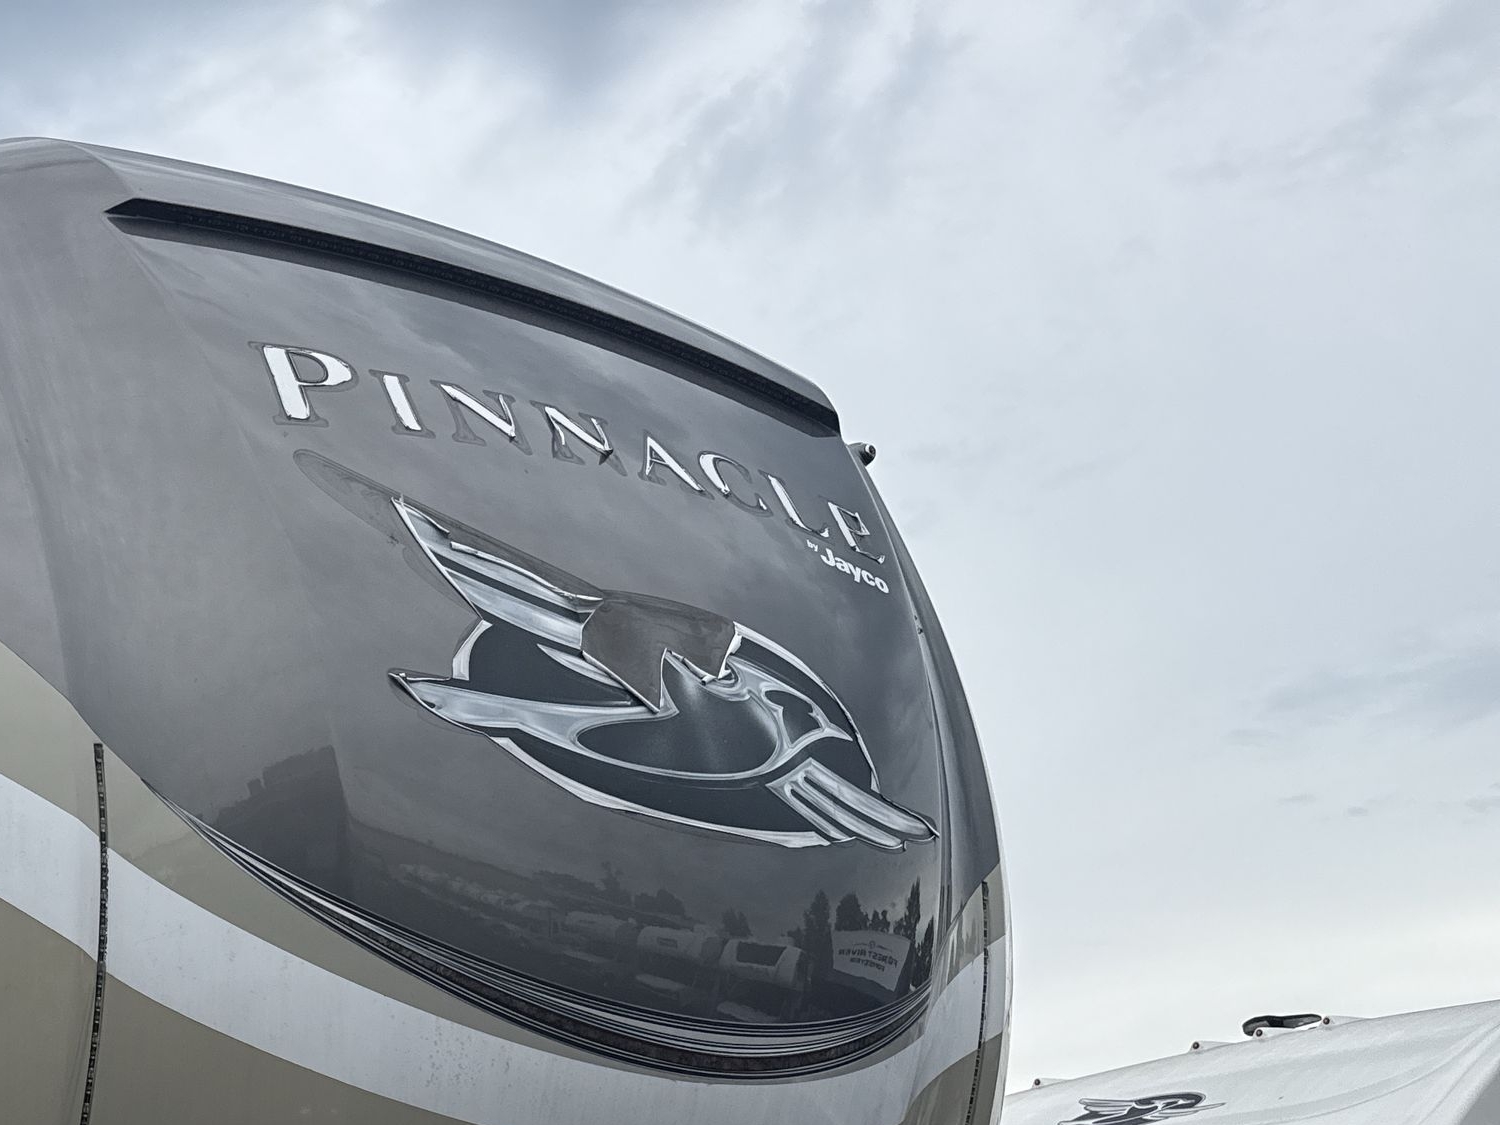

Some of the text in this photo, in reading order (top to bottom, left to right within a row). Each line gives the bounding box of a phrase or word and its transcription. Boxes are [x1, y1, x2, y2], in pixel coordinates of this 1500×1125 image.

[248, 341, 887, 564] PINNACLE
[806, 539, 889, 594] by Jayco
